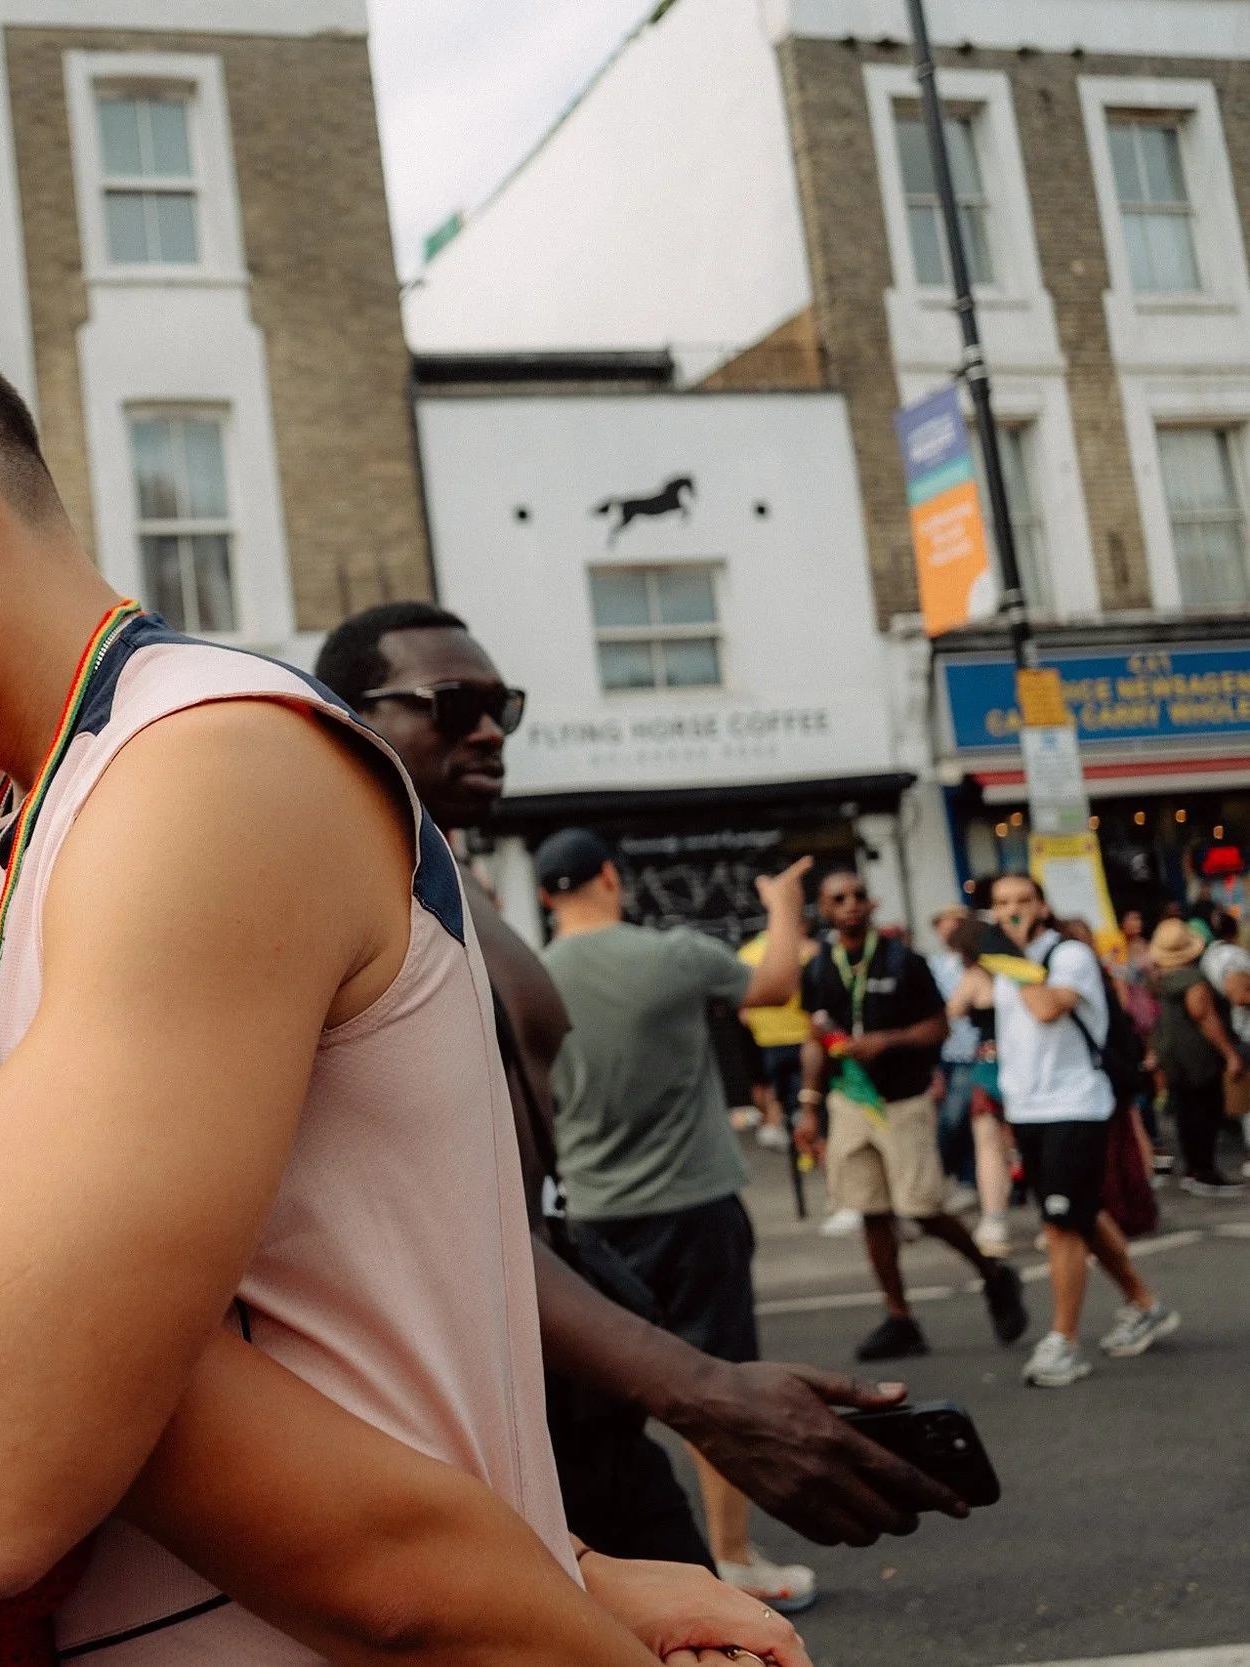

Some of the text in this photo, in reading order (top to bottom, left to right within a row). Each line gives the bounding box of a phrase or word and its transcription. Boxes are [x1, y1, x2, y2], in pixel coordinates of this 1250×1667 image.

[526, 706, 830, 748] FLYING HORSE COFFEE
